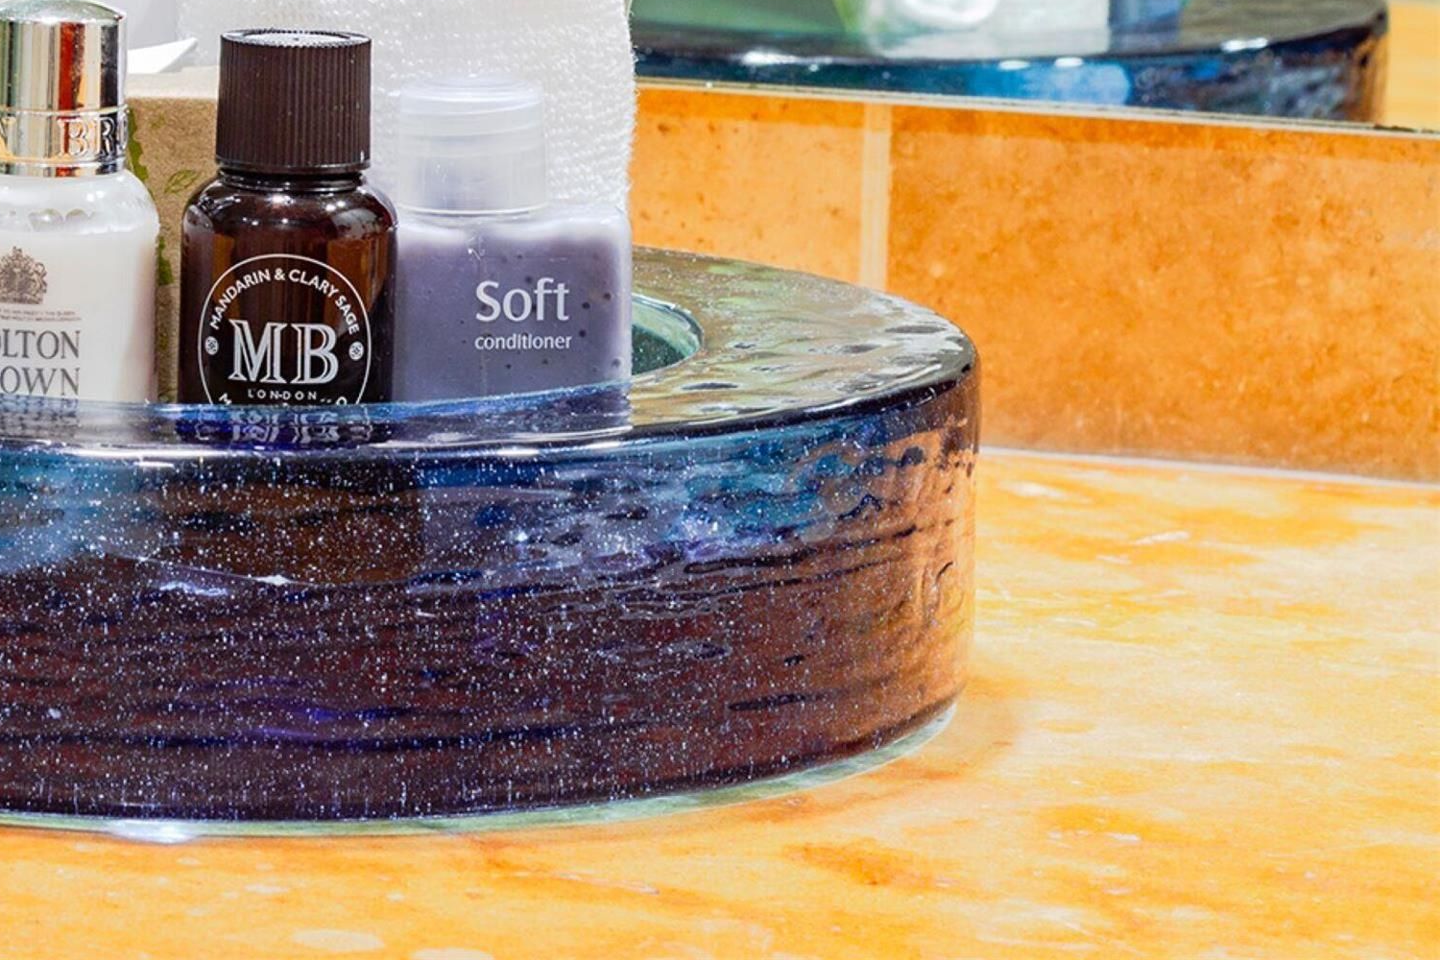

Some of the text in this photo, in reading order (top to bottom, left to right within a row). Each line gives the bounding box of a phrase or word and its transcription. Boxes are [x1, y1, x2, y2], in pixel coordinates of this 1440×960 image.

[210, 267, 361, 336] MANDARIN & CLARY SAGE
[475, 276, 570, 323] Soft
[227, 318, 339, 385] MB
[473, 332, 573, 351] conditioner
[247, 388, 318, 401] LONDON
